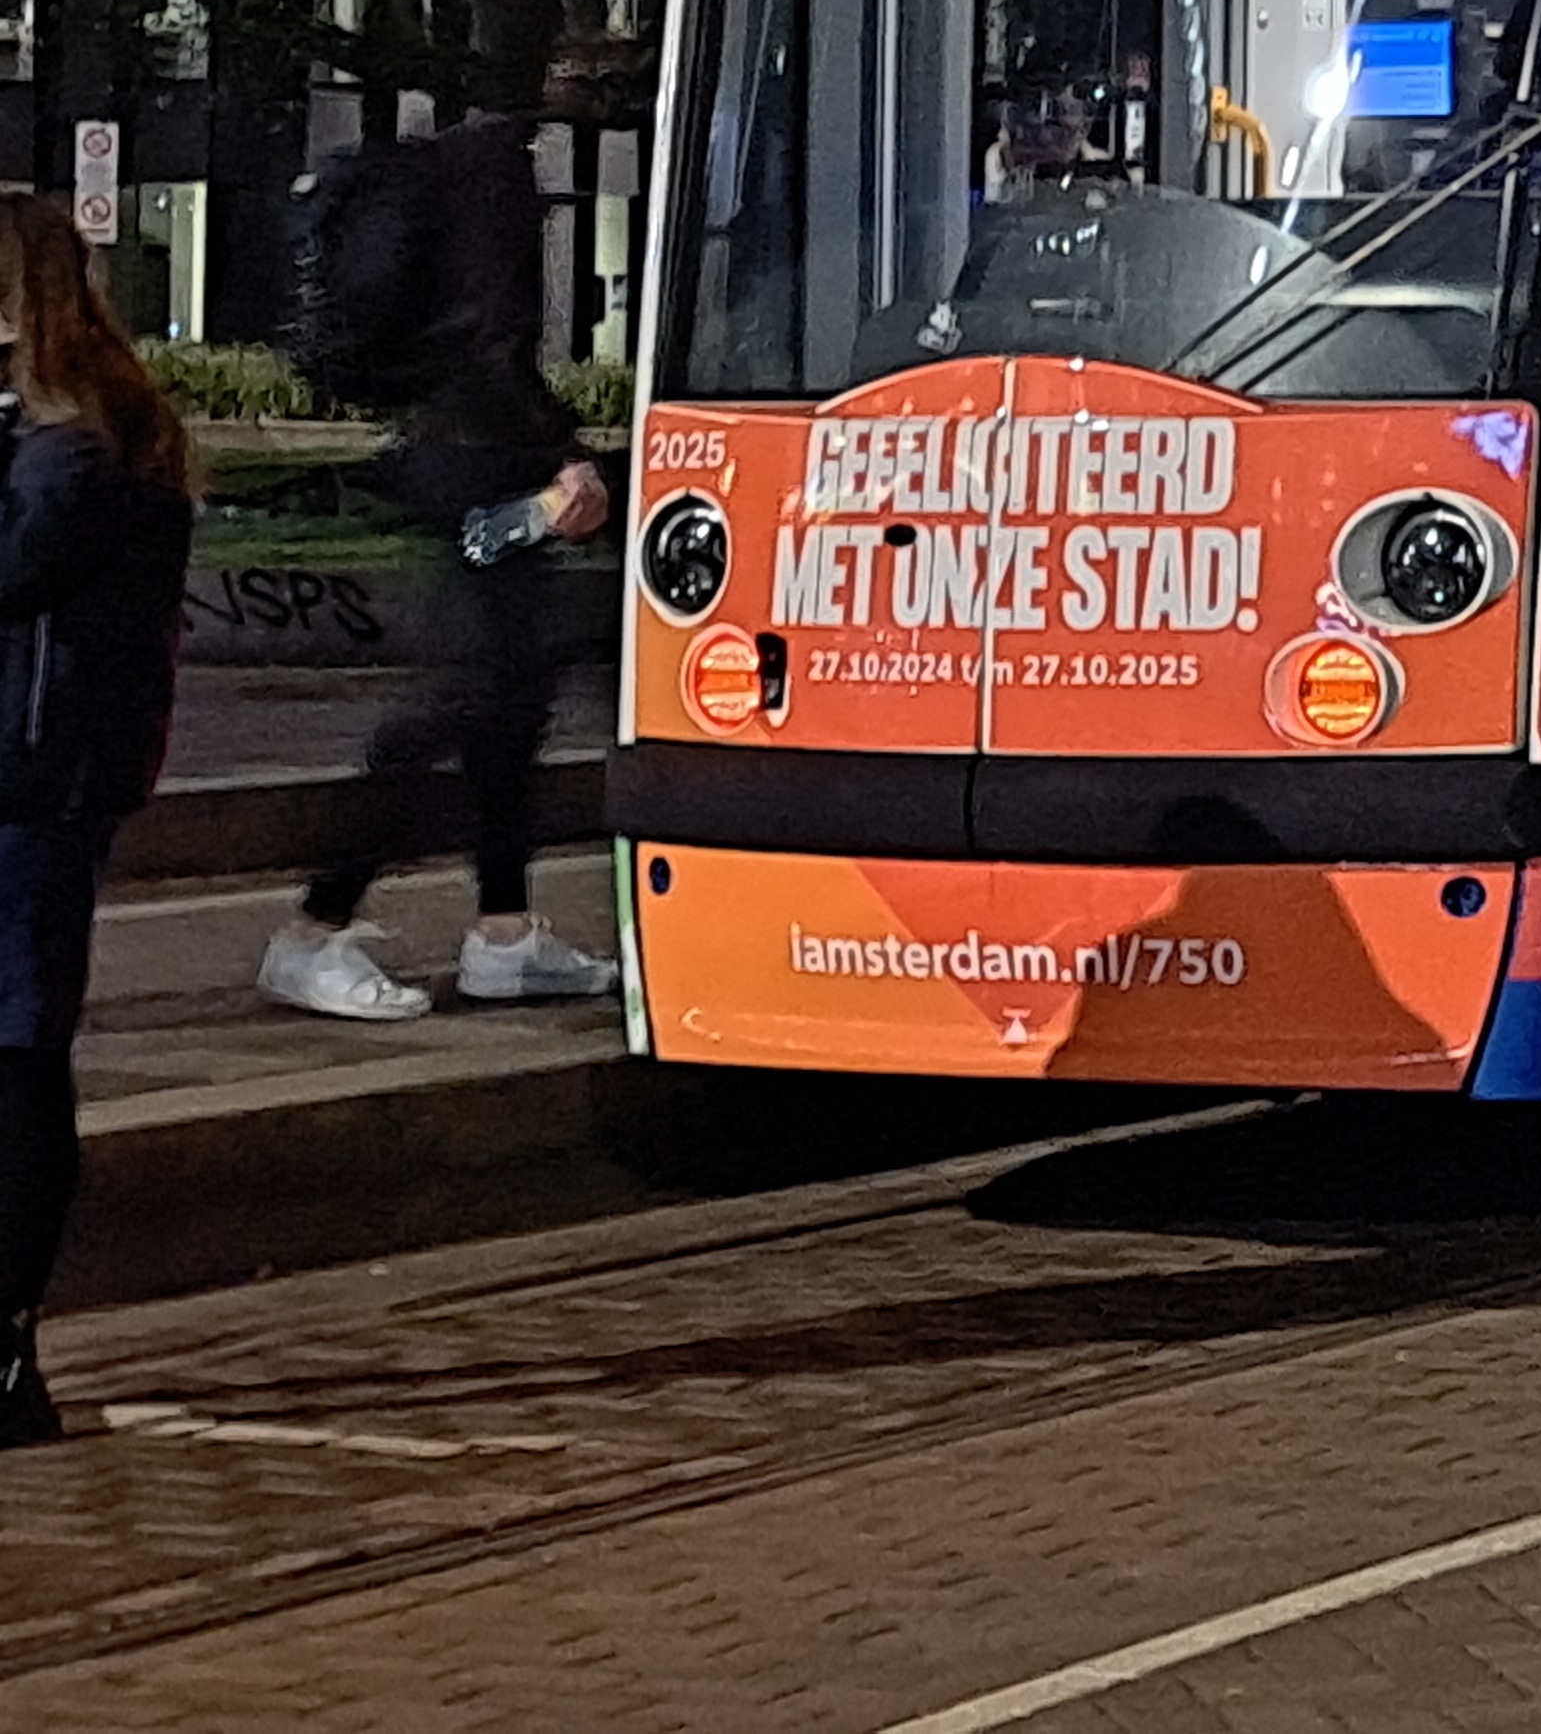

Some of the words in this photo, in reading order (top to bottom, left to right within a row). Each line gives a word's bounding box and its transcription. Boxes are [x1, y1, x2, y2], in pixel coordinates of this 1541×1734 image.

[648, 429, 726, 470] 2025
[800, 416, 1236, 516] GEFELICITEERD
[770, 523, 885, 627] MET
[892, 524, 1050, 630] ONZE
[1061, 526, 1262, 633] STAD!
[807, 649, 953, 683] 27.10.2024
[1021, 653, 1199, 686] 27.10.2025
